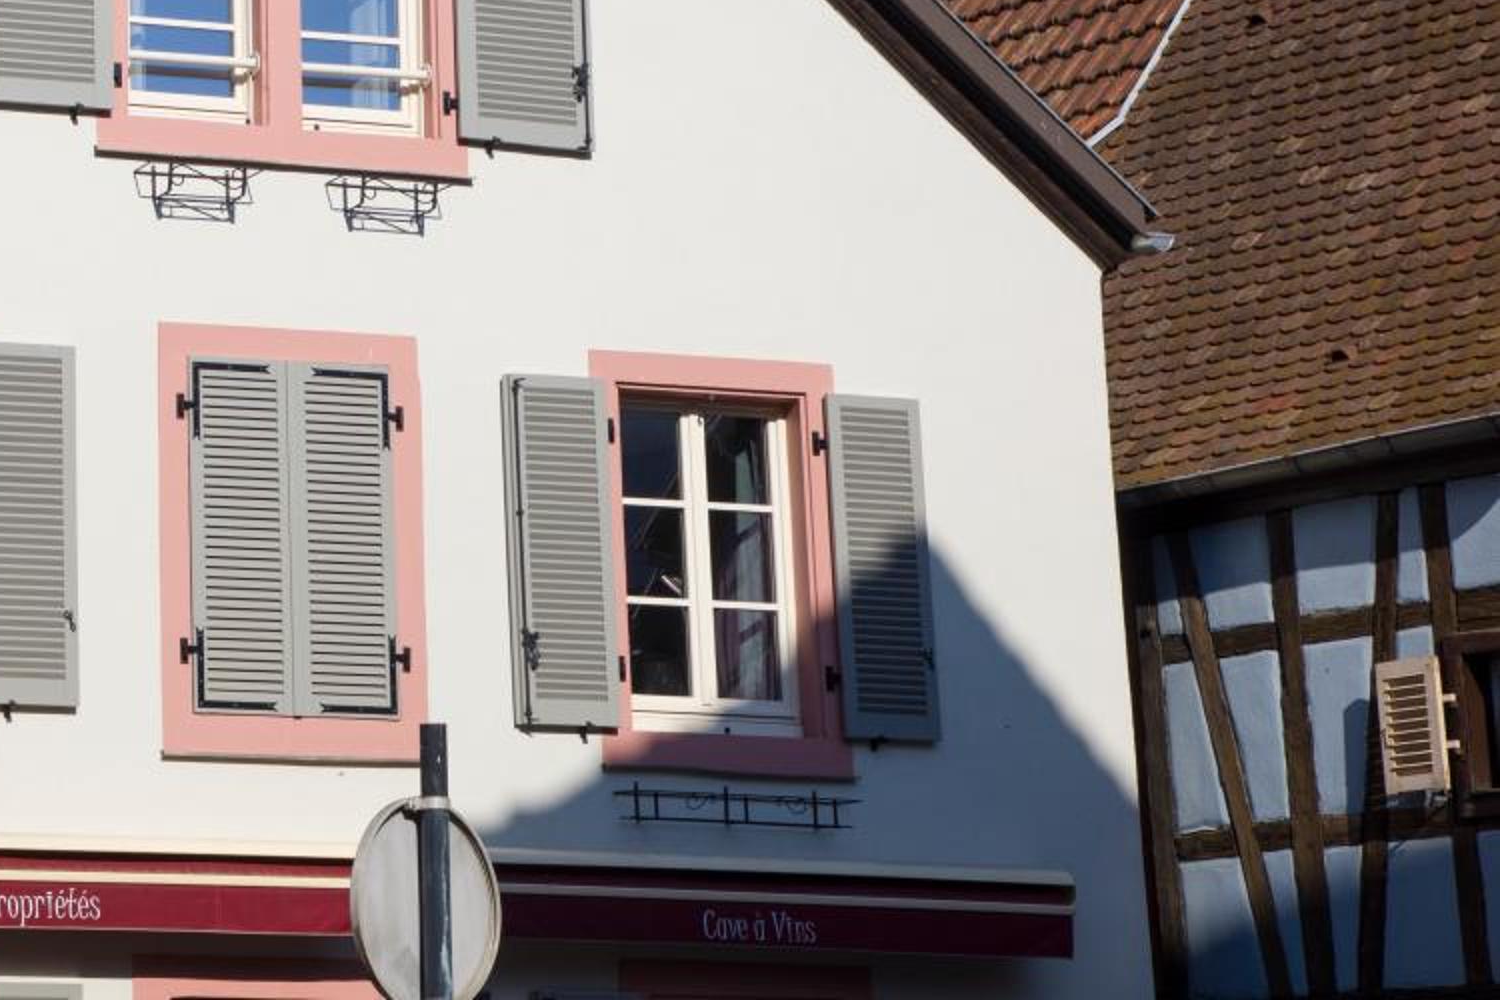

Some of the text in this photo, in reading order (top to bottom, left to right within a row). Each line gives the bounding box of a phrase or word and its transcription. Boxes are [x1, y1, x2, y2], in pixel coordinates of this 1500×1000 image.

[703, 909, 817, 944] Cave à Vins
